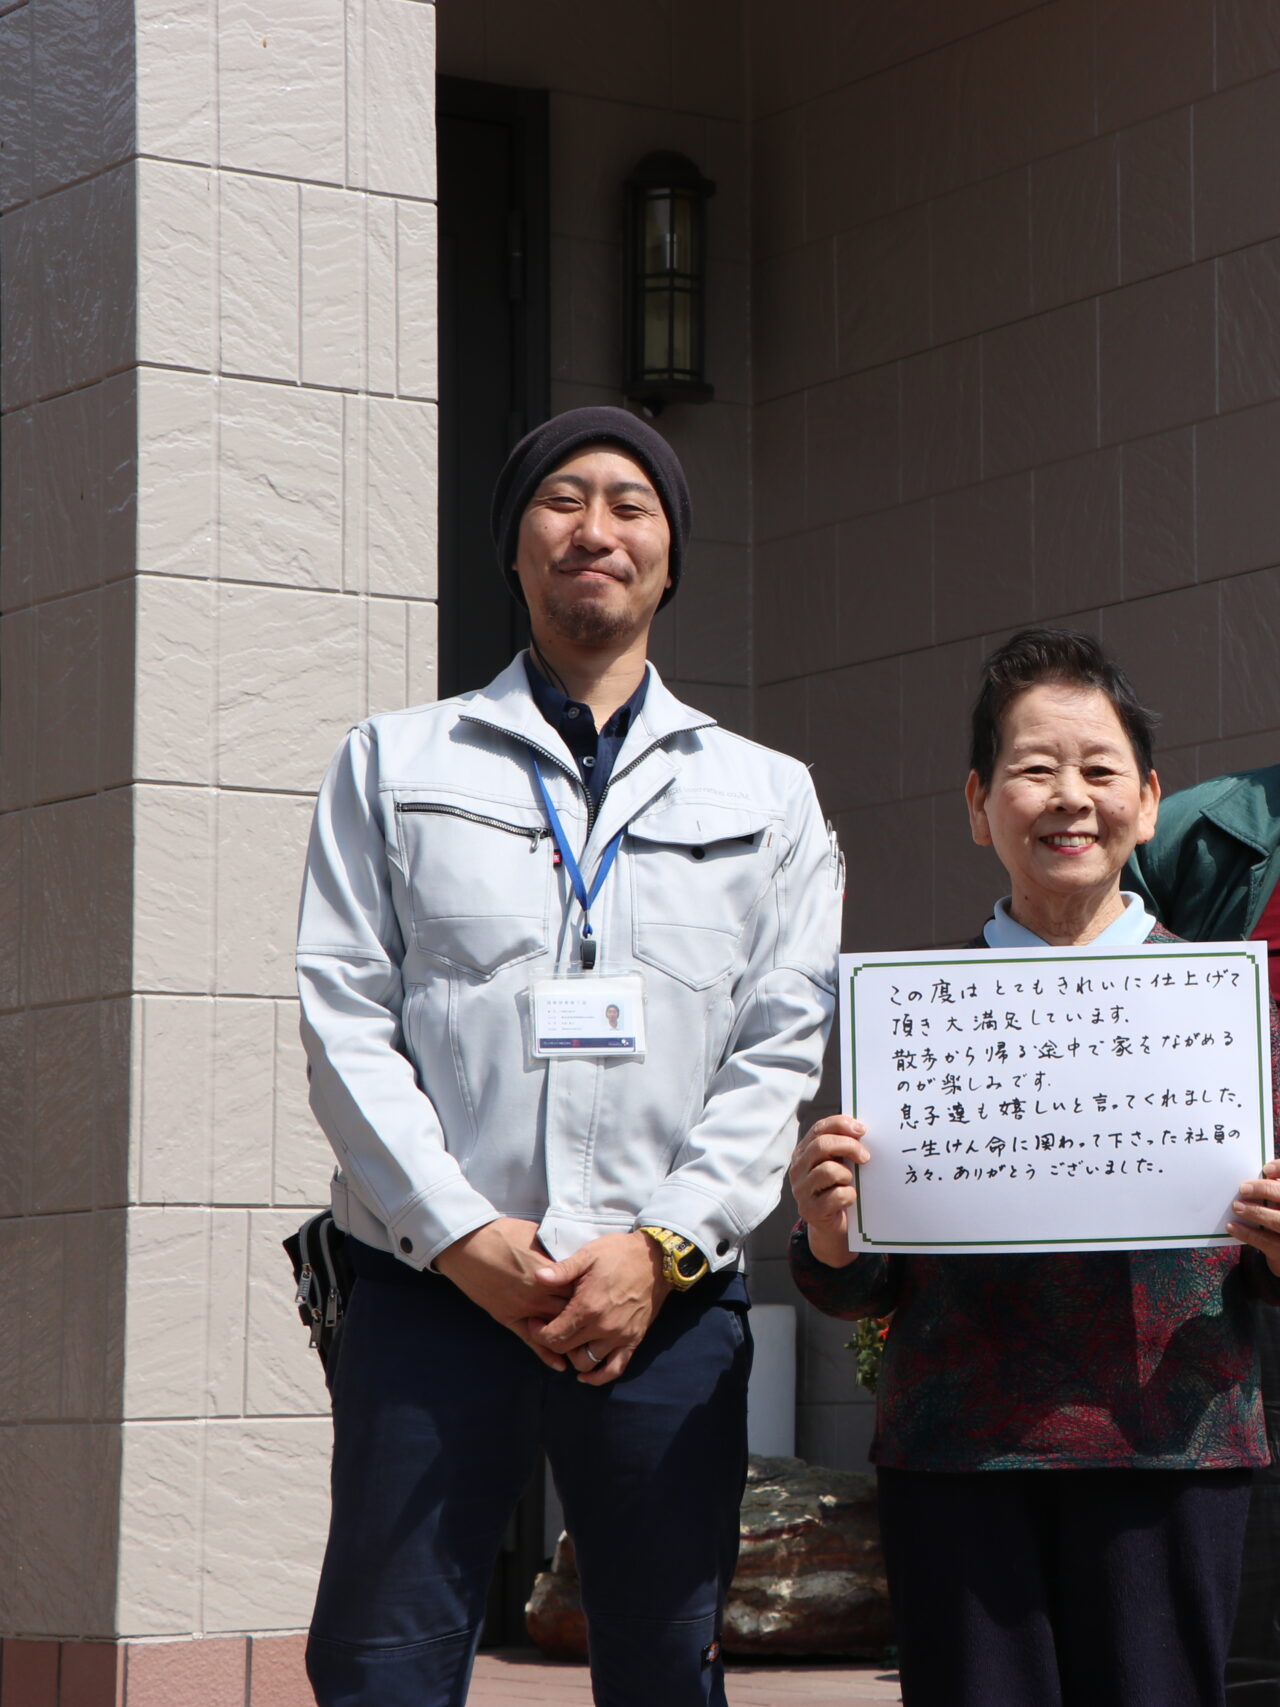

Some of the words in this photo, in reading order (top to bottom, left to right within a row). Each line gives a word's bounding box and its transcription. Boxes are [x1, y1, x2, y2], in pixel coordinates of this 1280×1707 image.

[891, 1031, 1234, 1072] 散歩から帰る途中で家をながめる
